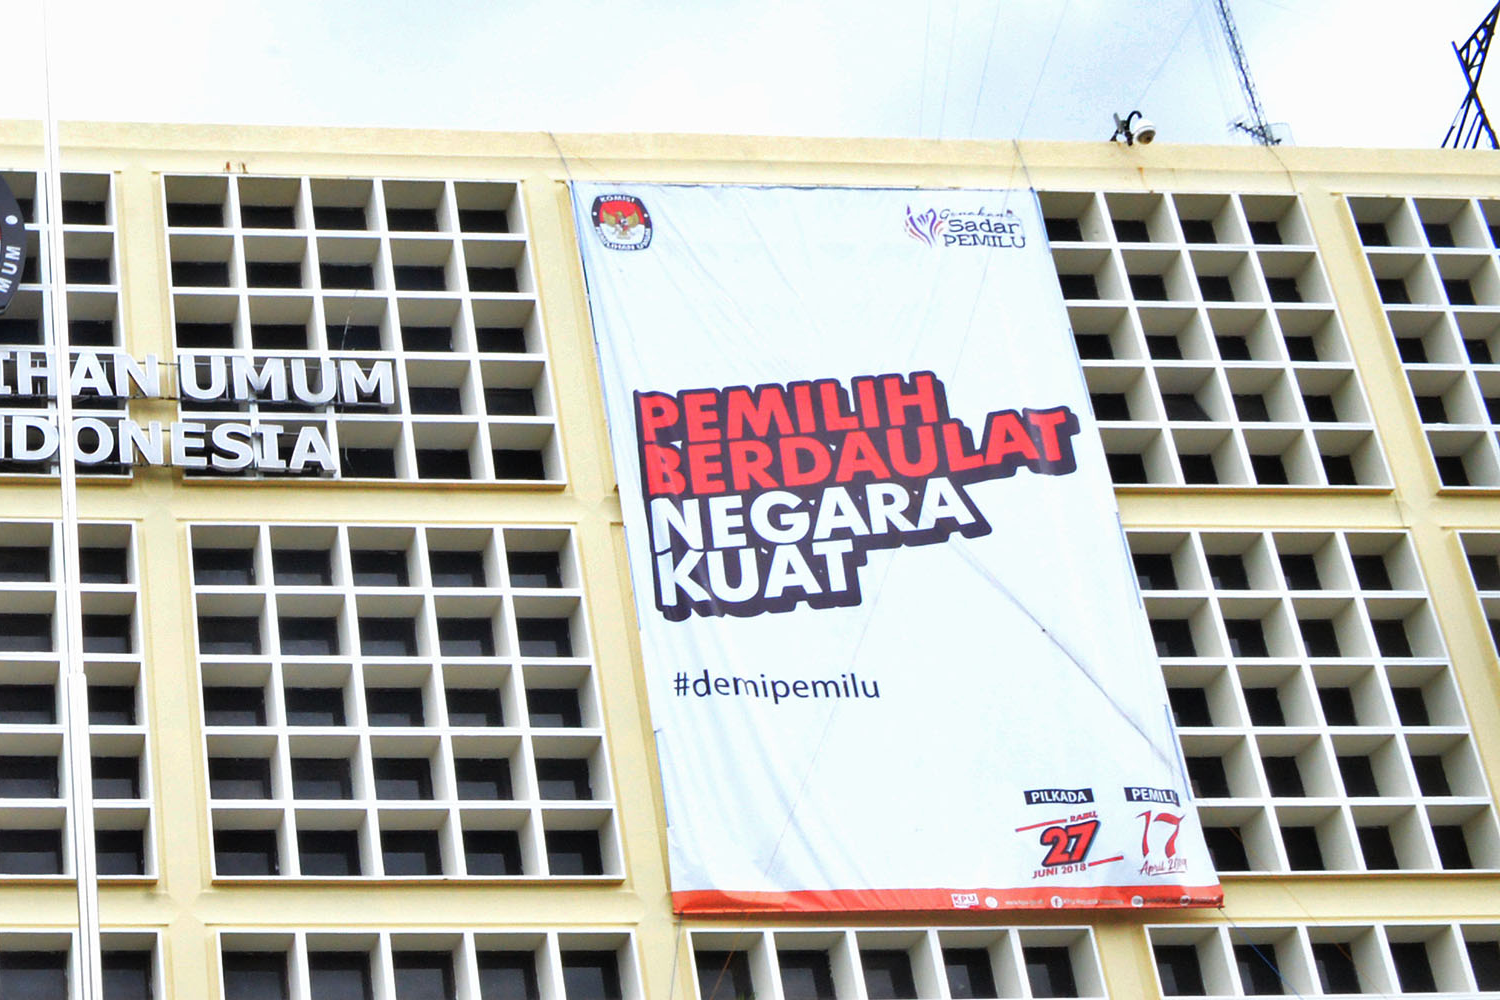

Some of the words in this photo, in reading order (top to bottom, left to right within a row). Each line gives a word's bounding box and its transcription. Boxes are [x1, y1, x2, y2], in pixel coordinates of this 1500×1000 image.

[942, 233, 1026, 248] PEMILU
[948, 219, 1020, 234] Sadar
[179, 355, 396, 405] UMUM
[639, 373, 938, 443] PEMILIH
[646, 410, 1067, 495] BERDAULAT
[650, 477, 978, 553] NEGARA
[656, 539, 855, 607] KUAT
[673, 670, 881, 704] #demipemilu
[1031, 791, 1087, 803] PILKADA
[1040, 820, 1100, 867] 27
[1136, 810, 1186, 859] 17
[1032, 867, 1057, 879] JUNI
[1061, 863, 1086, 875] 2018
[1139, 860, 1165, 876] April
[953, 894, 976, 903] KPU
